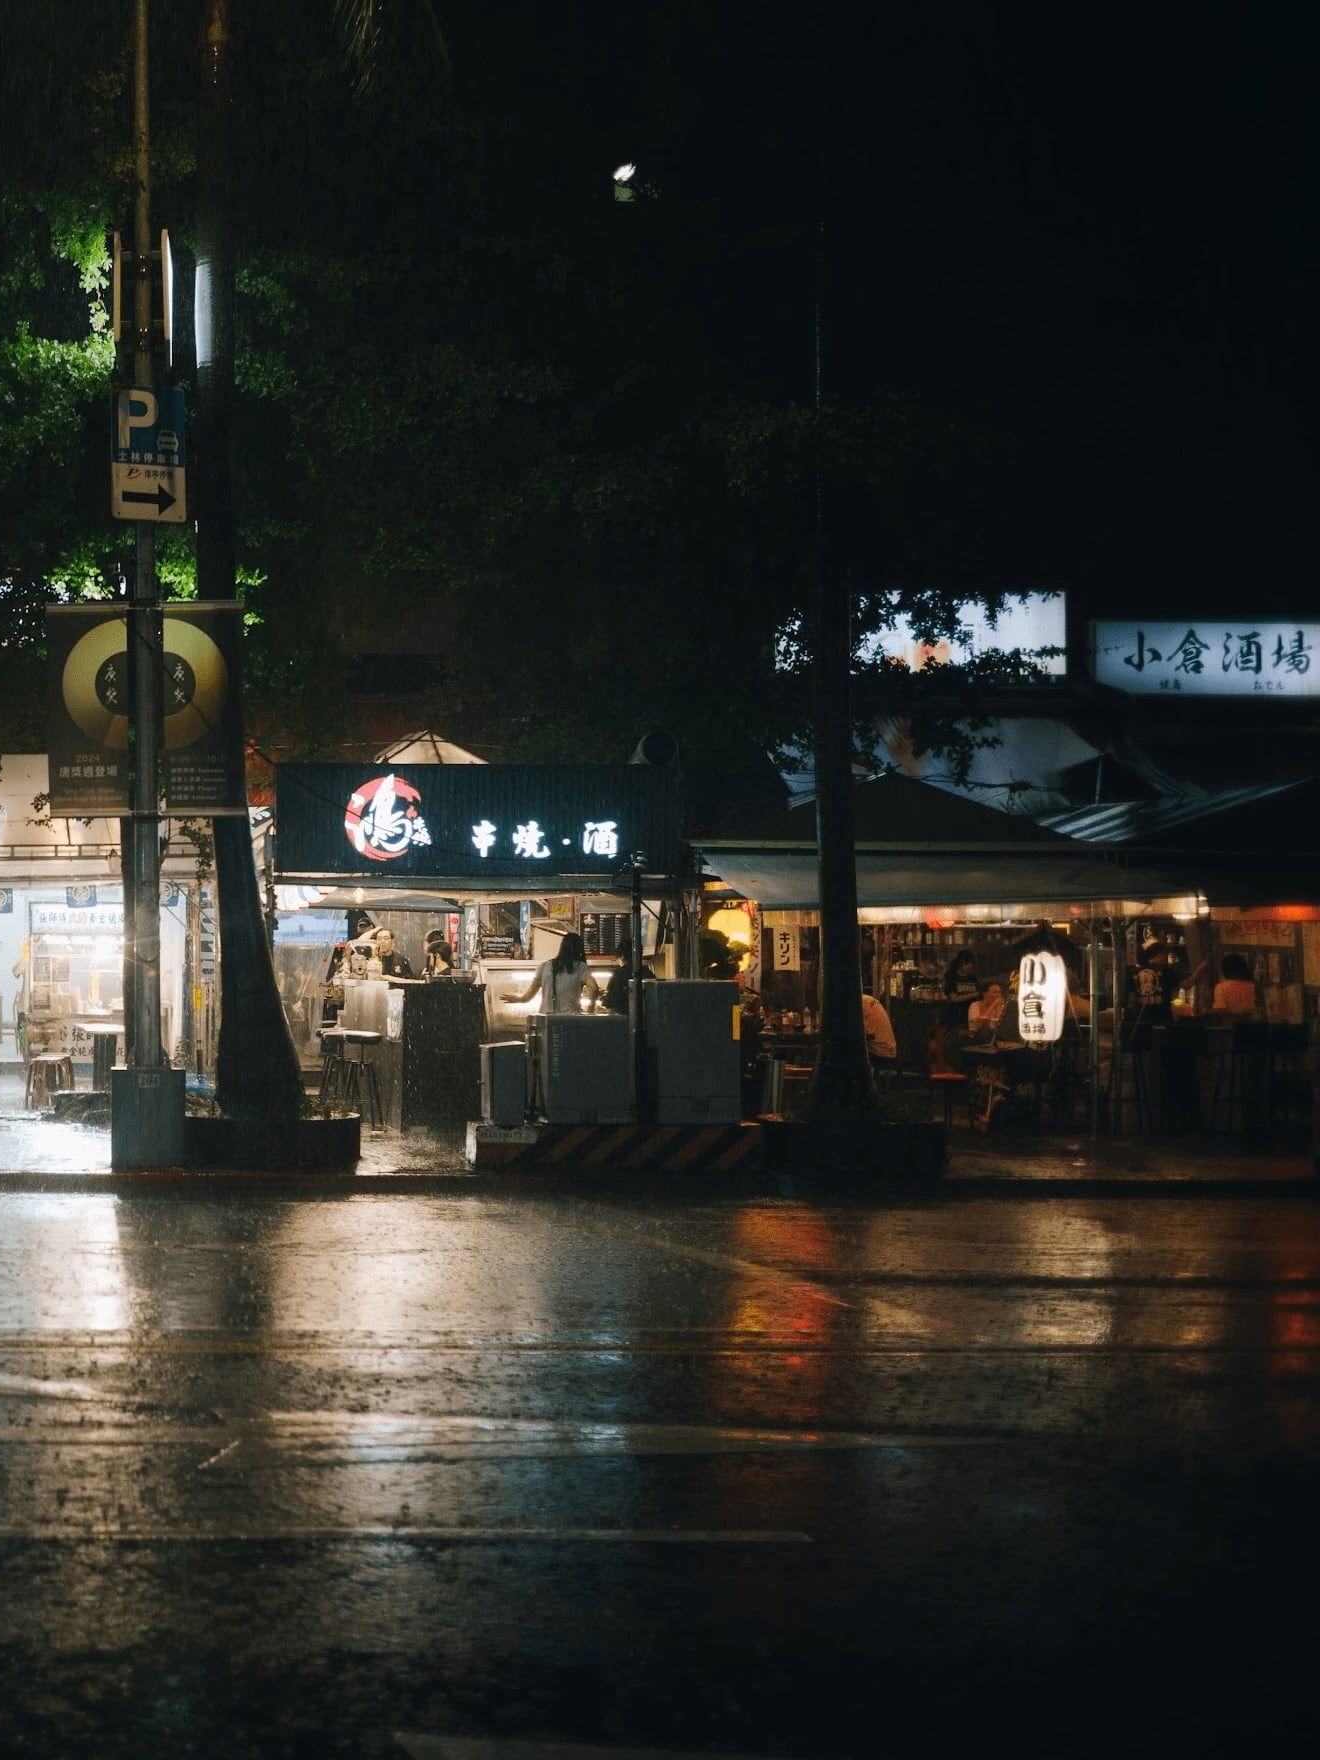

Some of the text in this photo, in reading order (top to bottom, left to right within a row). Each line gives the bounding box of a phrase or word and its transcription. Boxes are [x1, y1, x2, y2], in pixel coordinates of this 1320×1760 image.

[118, 389, 158, 449] P
[1123, 628, 1312, 675] 小倉酒場
[75, 754, 100, 763] 2024
[779, 931, 791, 966] キリン
